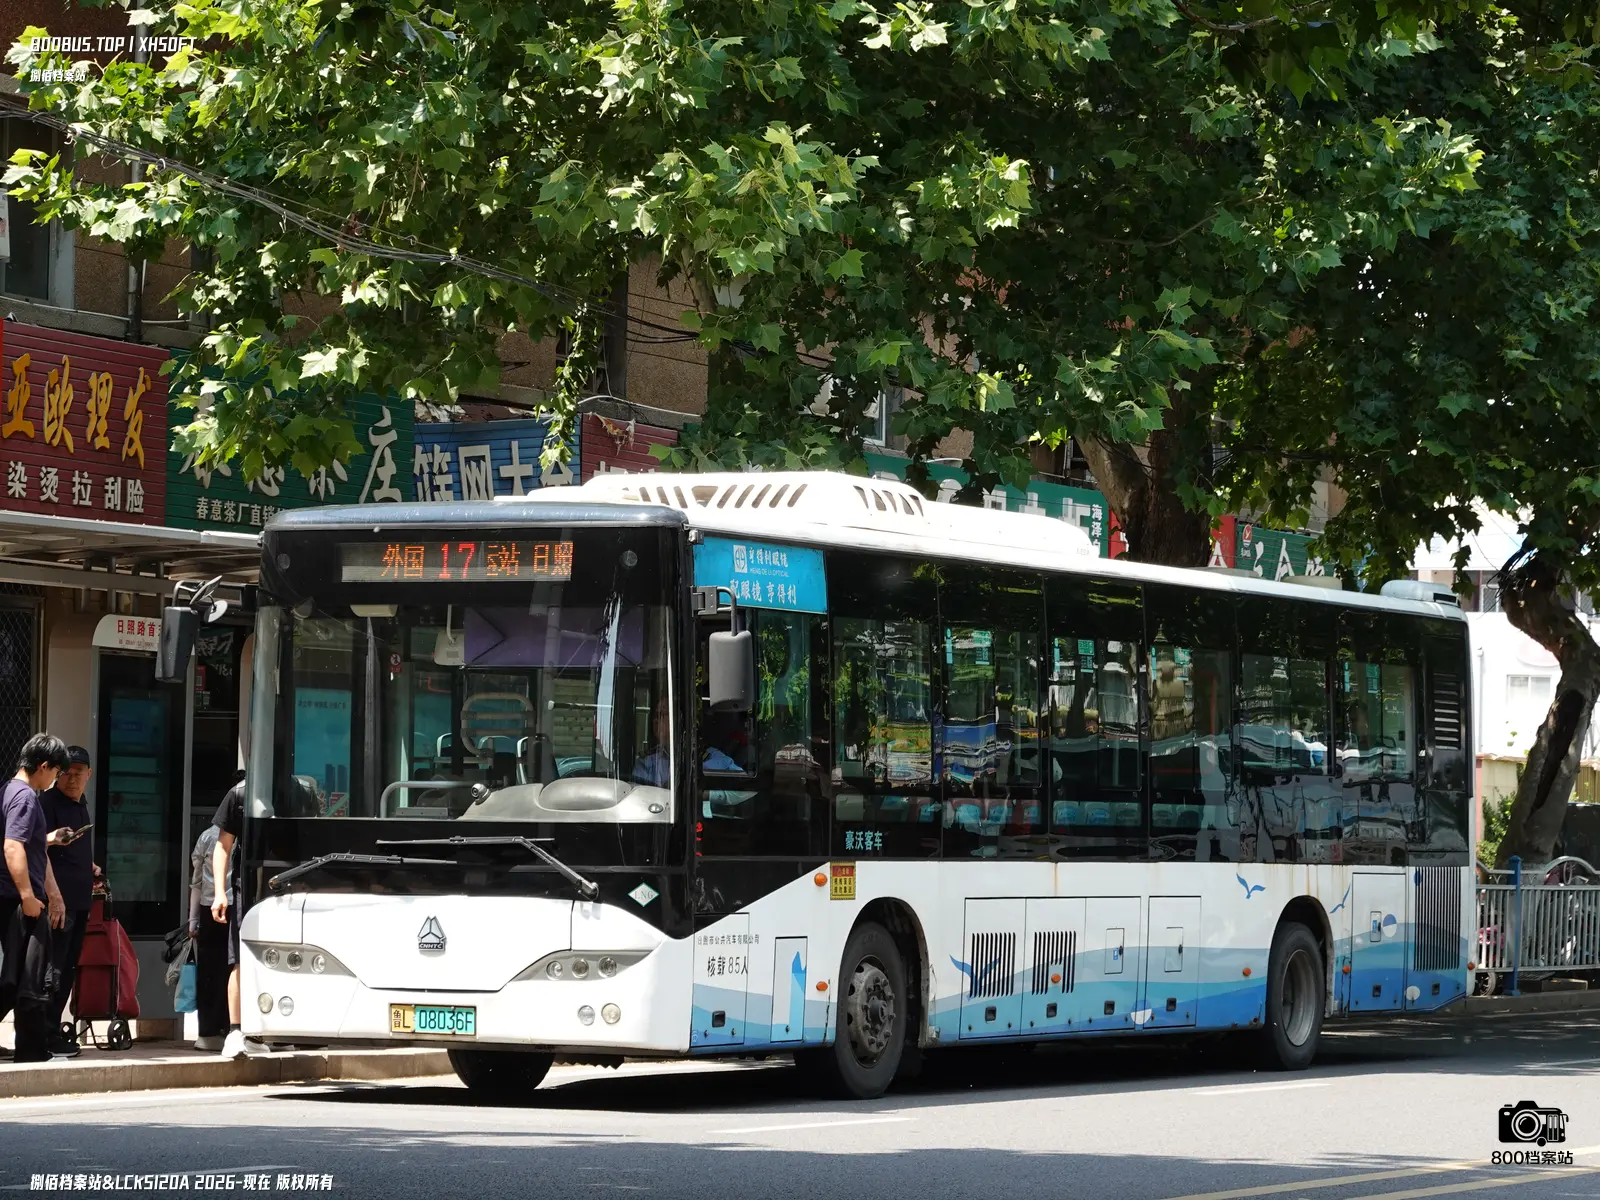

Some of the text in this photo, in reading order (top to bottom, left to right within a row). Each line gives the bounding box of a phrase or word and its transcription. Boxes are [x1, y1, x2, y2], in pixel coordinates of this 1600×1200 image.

[2, 353, 151, 470] 亚欧理发
[7, 460, 145, 514] 染烫拉刮脸
[196, 496, 284, 526] 春意茶厂直销
[380, 544, 425, 579] 外国
[438, 543, 475, 579] 17
[766, 581, 797, 605] 亨得利
[117, 619, 161, 637] 日照路首
[845, 830, 883, 850] 豪沃客车
[634, 890, 654, 900] LNG
[393, 1009, 473, 1031] 鲁L 08036F
